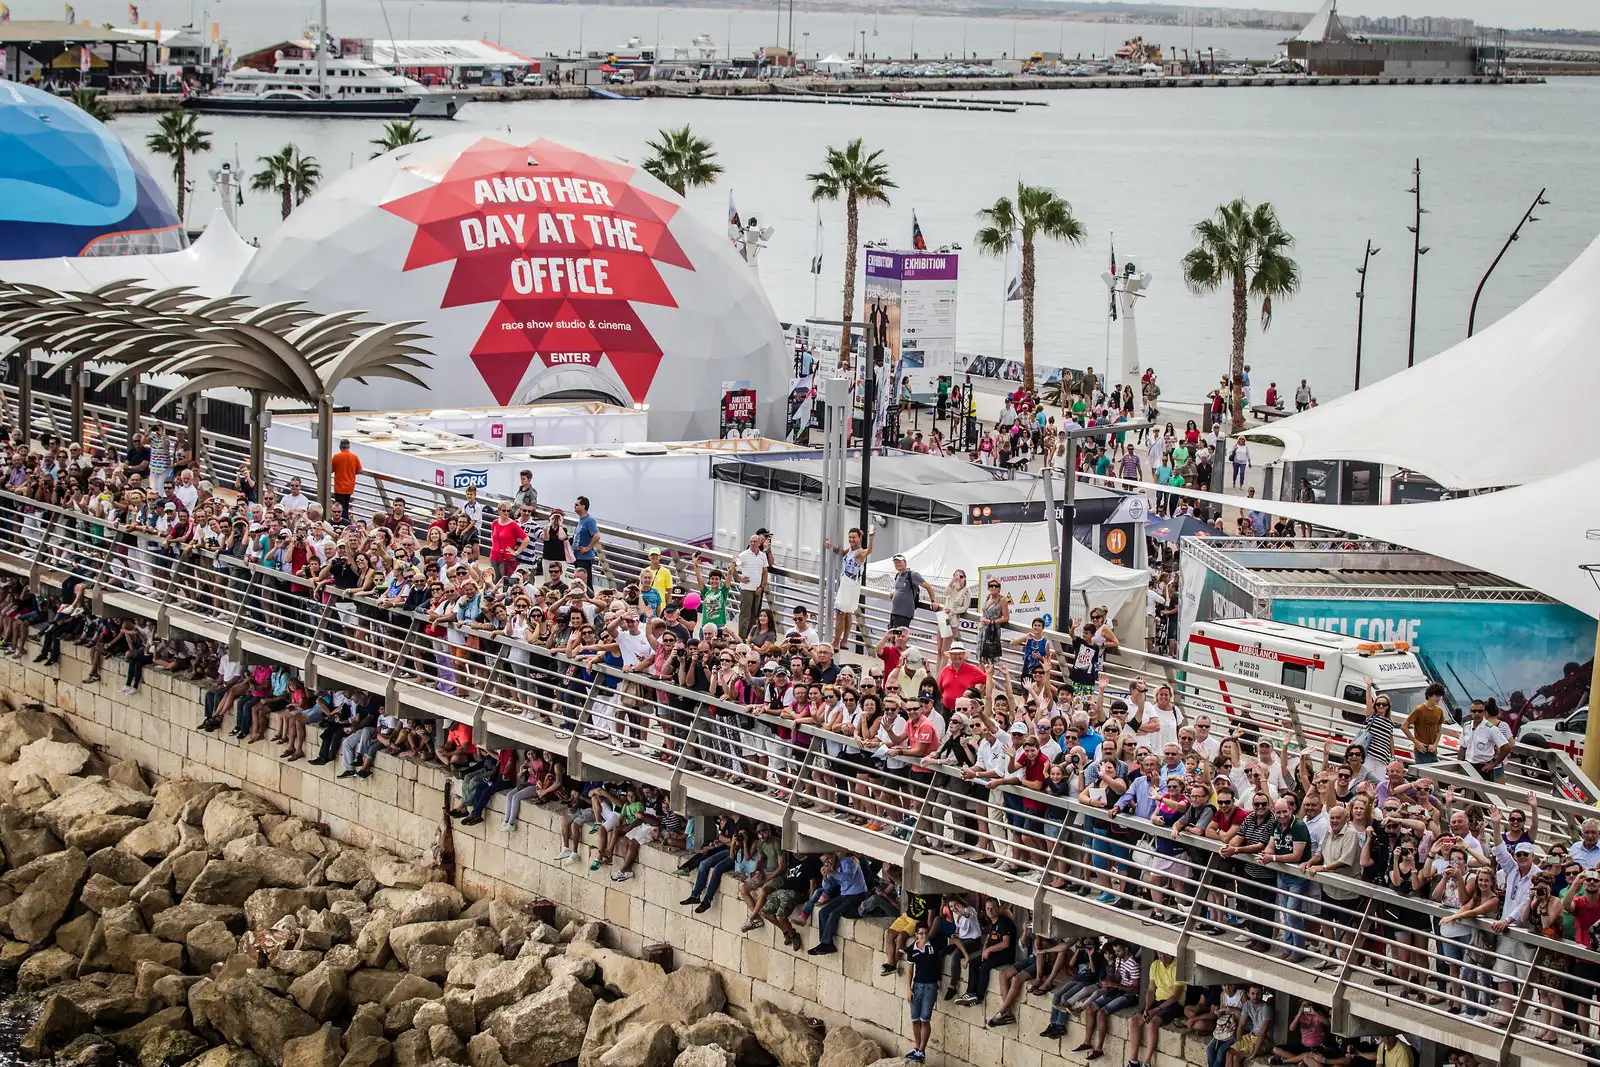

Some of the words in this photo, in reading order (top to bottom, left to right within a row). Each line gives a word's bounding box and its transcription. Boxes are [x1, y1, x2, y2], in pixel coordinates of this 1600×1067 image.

[474, 177, 613, 206] ANOTHER
[460, 214, 525, 251] DAY
[538, 213, 576, 244] AT
[584, 213, 644, 252] THE
[868, 255, 893, 268] EXHIBITION
[904, 258, 946, 270] EXHIBITION
[511, 258, 613, 294] OFFICE
[502, 321, 524, 330] race
[526, 320, 553, 329] show
[556, 320, 586, 329] studio
[588, 320, 596, 328] &
[598, 320, 632, 331] cinema
[550, 353, 591, 362] ENTER
[455, 476, 486, 486] TORK
[1238, 646, 1278, 660] AMBULANCIA
